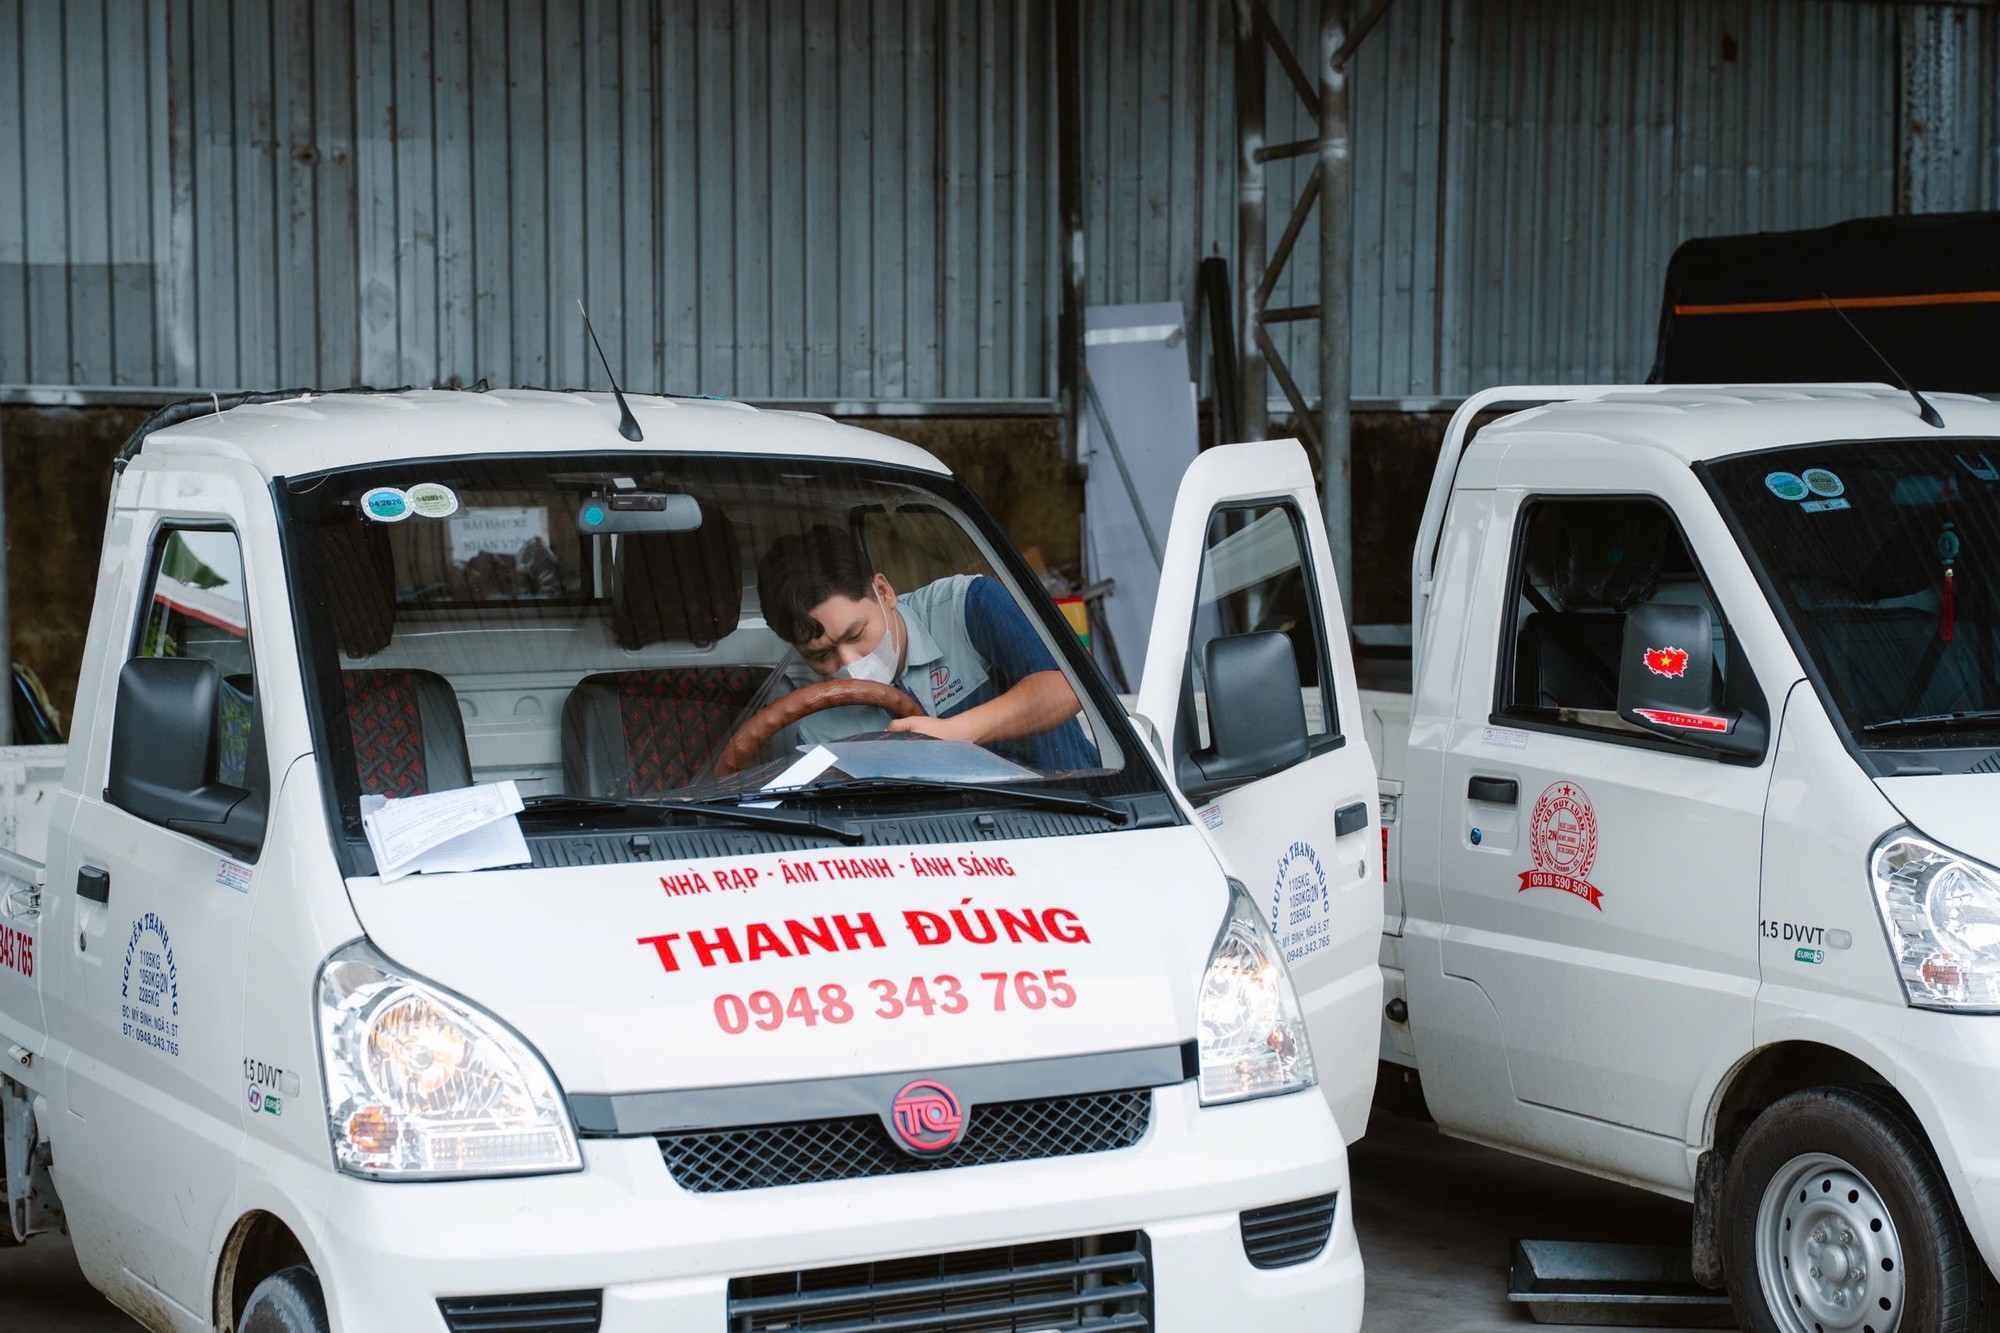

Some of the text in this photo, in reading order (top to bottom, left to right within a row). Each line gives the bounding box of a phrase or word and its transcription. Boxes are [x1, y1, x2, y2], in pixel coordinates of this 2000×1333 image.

[1289, 841, 1315, 865] THANH
[659, 868, 710, 897] NHÀ
[712, 867, 760, 893] RẠP
[778, 859, 818, 884] ÂM
[818, 858, 895, 880] THANH
[910, 852, 956, 878] ÁNH
[957, 851, 1017, 878] SÁNG
[1532, 873, 1588, 897] 0918 590 509
[145, 912, 169, 950] THANH
[636, 896, 1091, 973] THANH ĐÚNG
[1760, 920, 1824, 945] 1.5 DVVT
[17, 931, 33, 978] 765
[1287, 934, 1330, 962] 0948.343.765
[1796, 950, 1814, 960] EURO
[713, 968, 1077, 1035] 0948 343 765
[136, 1028, 179, 1056] 0948.343.765
